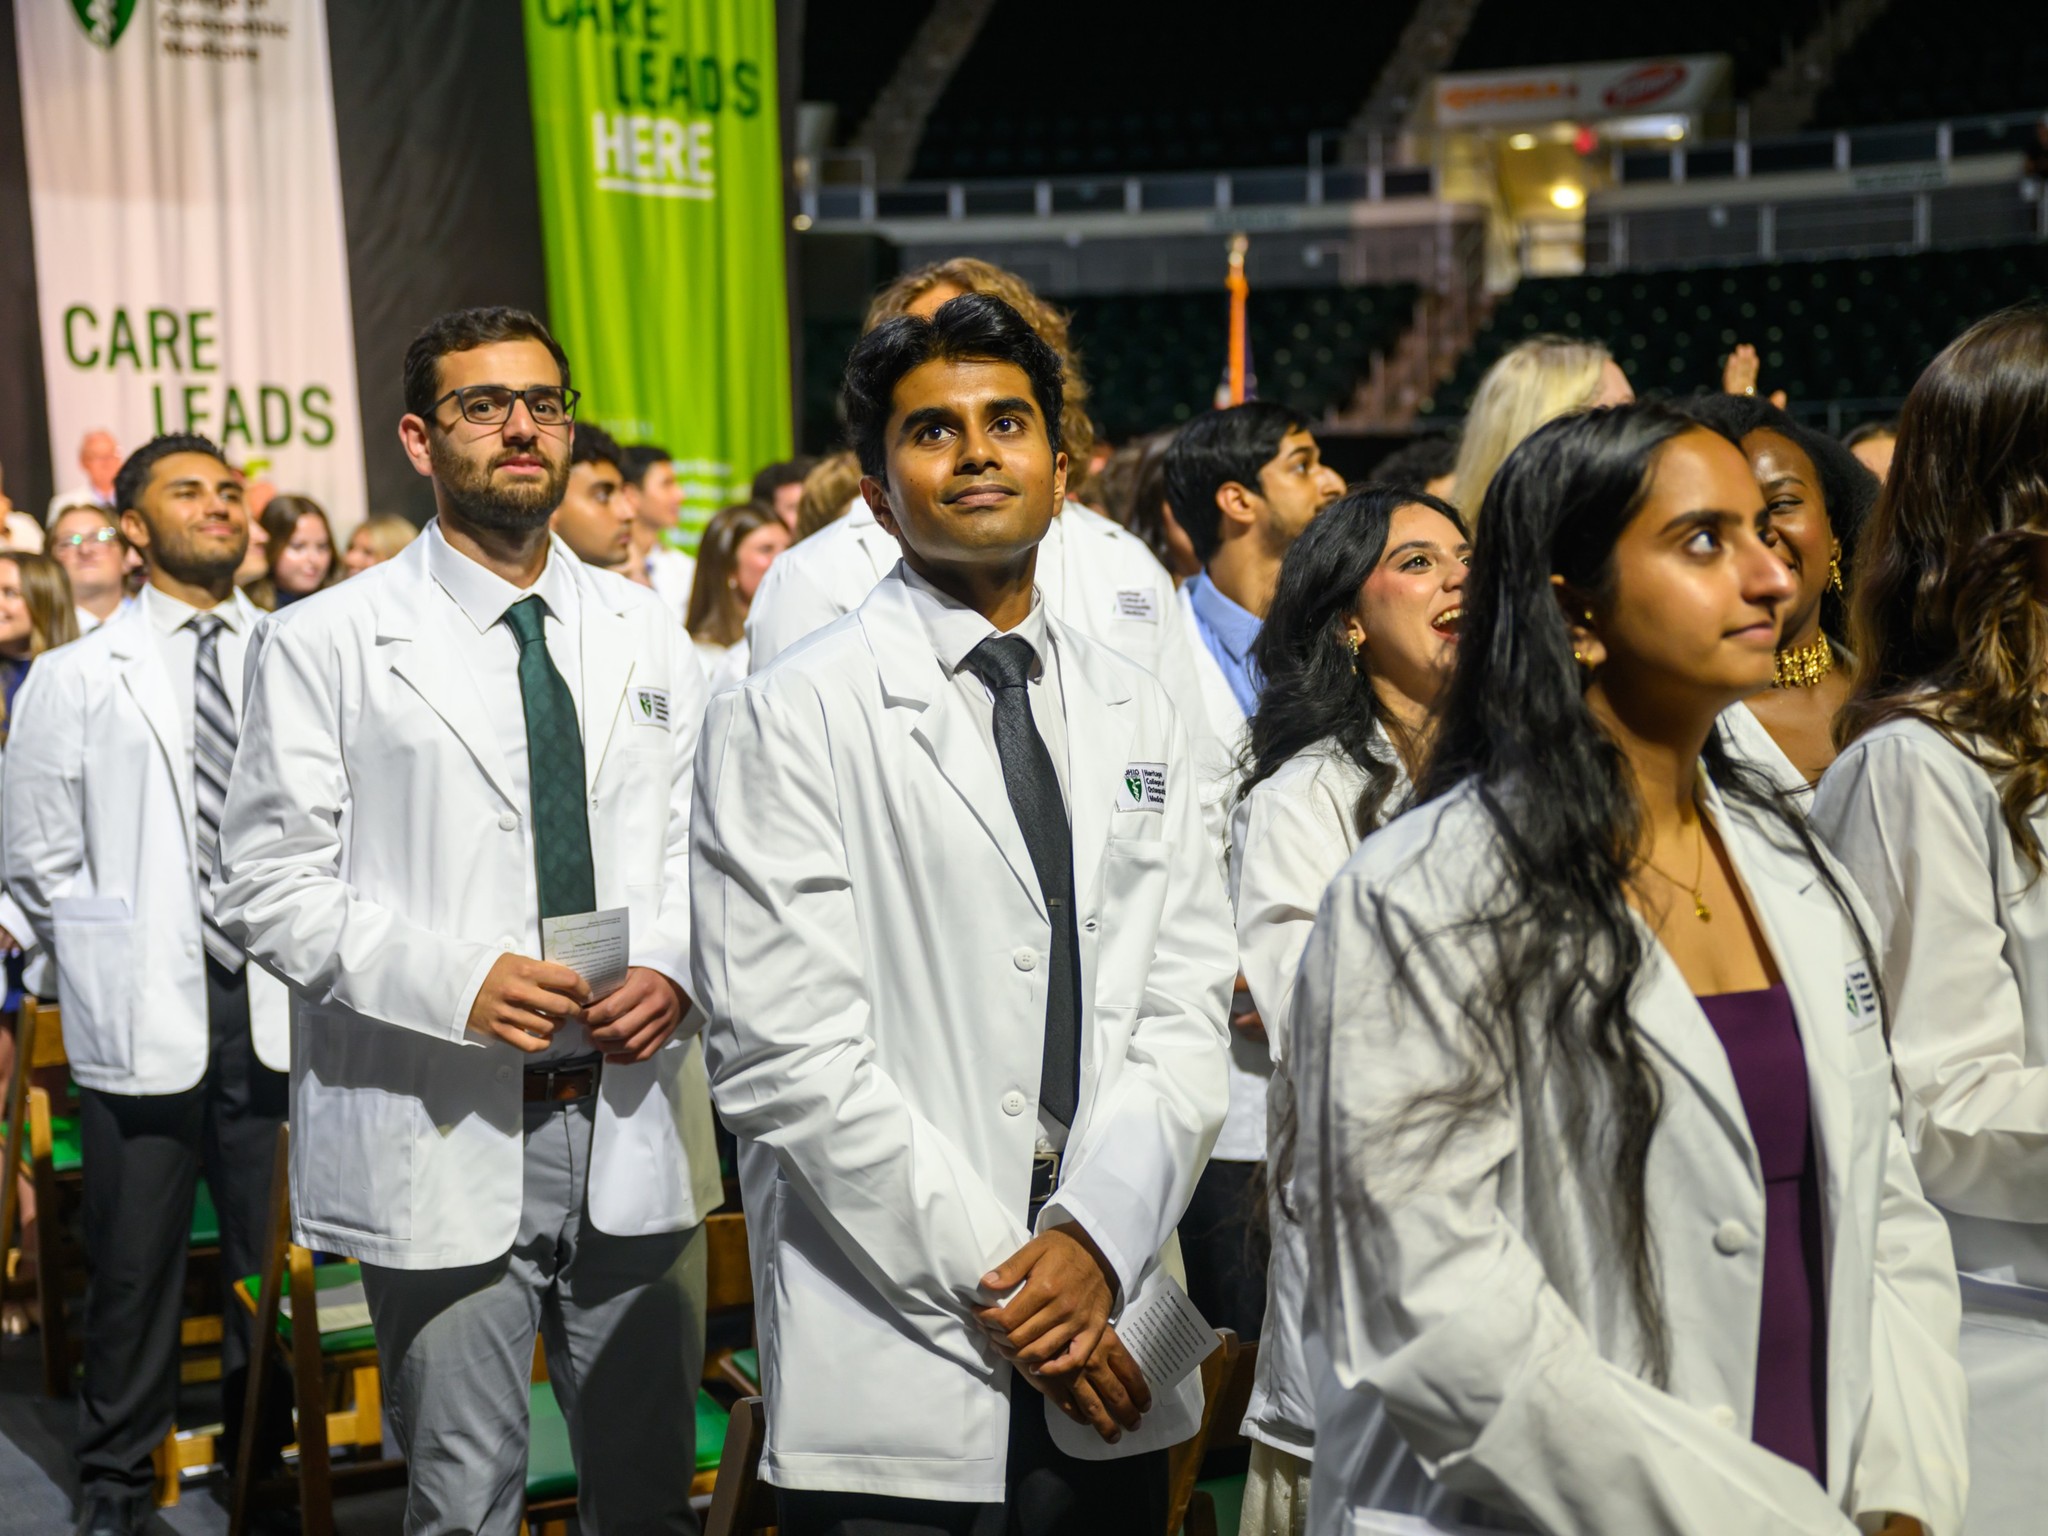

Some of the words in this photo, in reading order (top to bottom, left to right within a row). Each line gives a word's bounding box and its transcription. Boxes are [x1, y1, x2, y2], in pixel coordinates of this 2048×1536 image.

[614, 46, 760, 123] LEADS
[593, 111, 714, 185] HERE
[63, 305, 218, 372] CARE
[151, 384, 335, 447] LEADS
